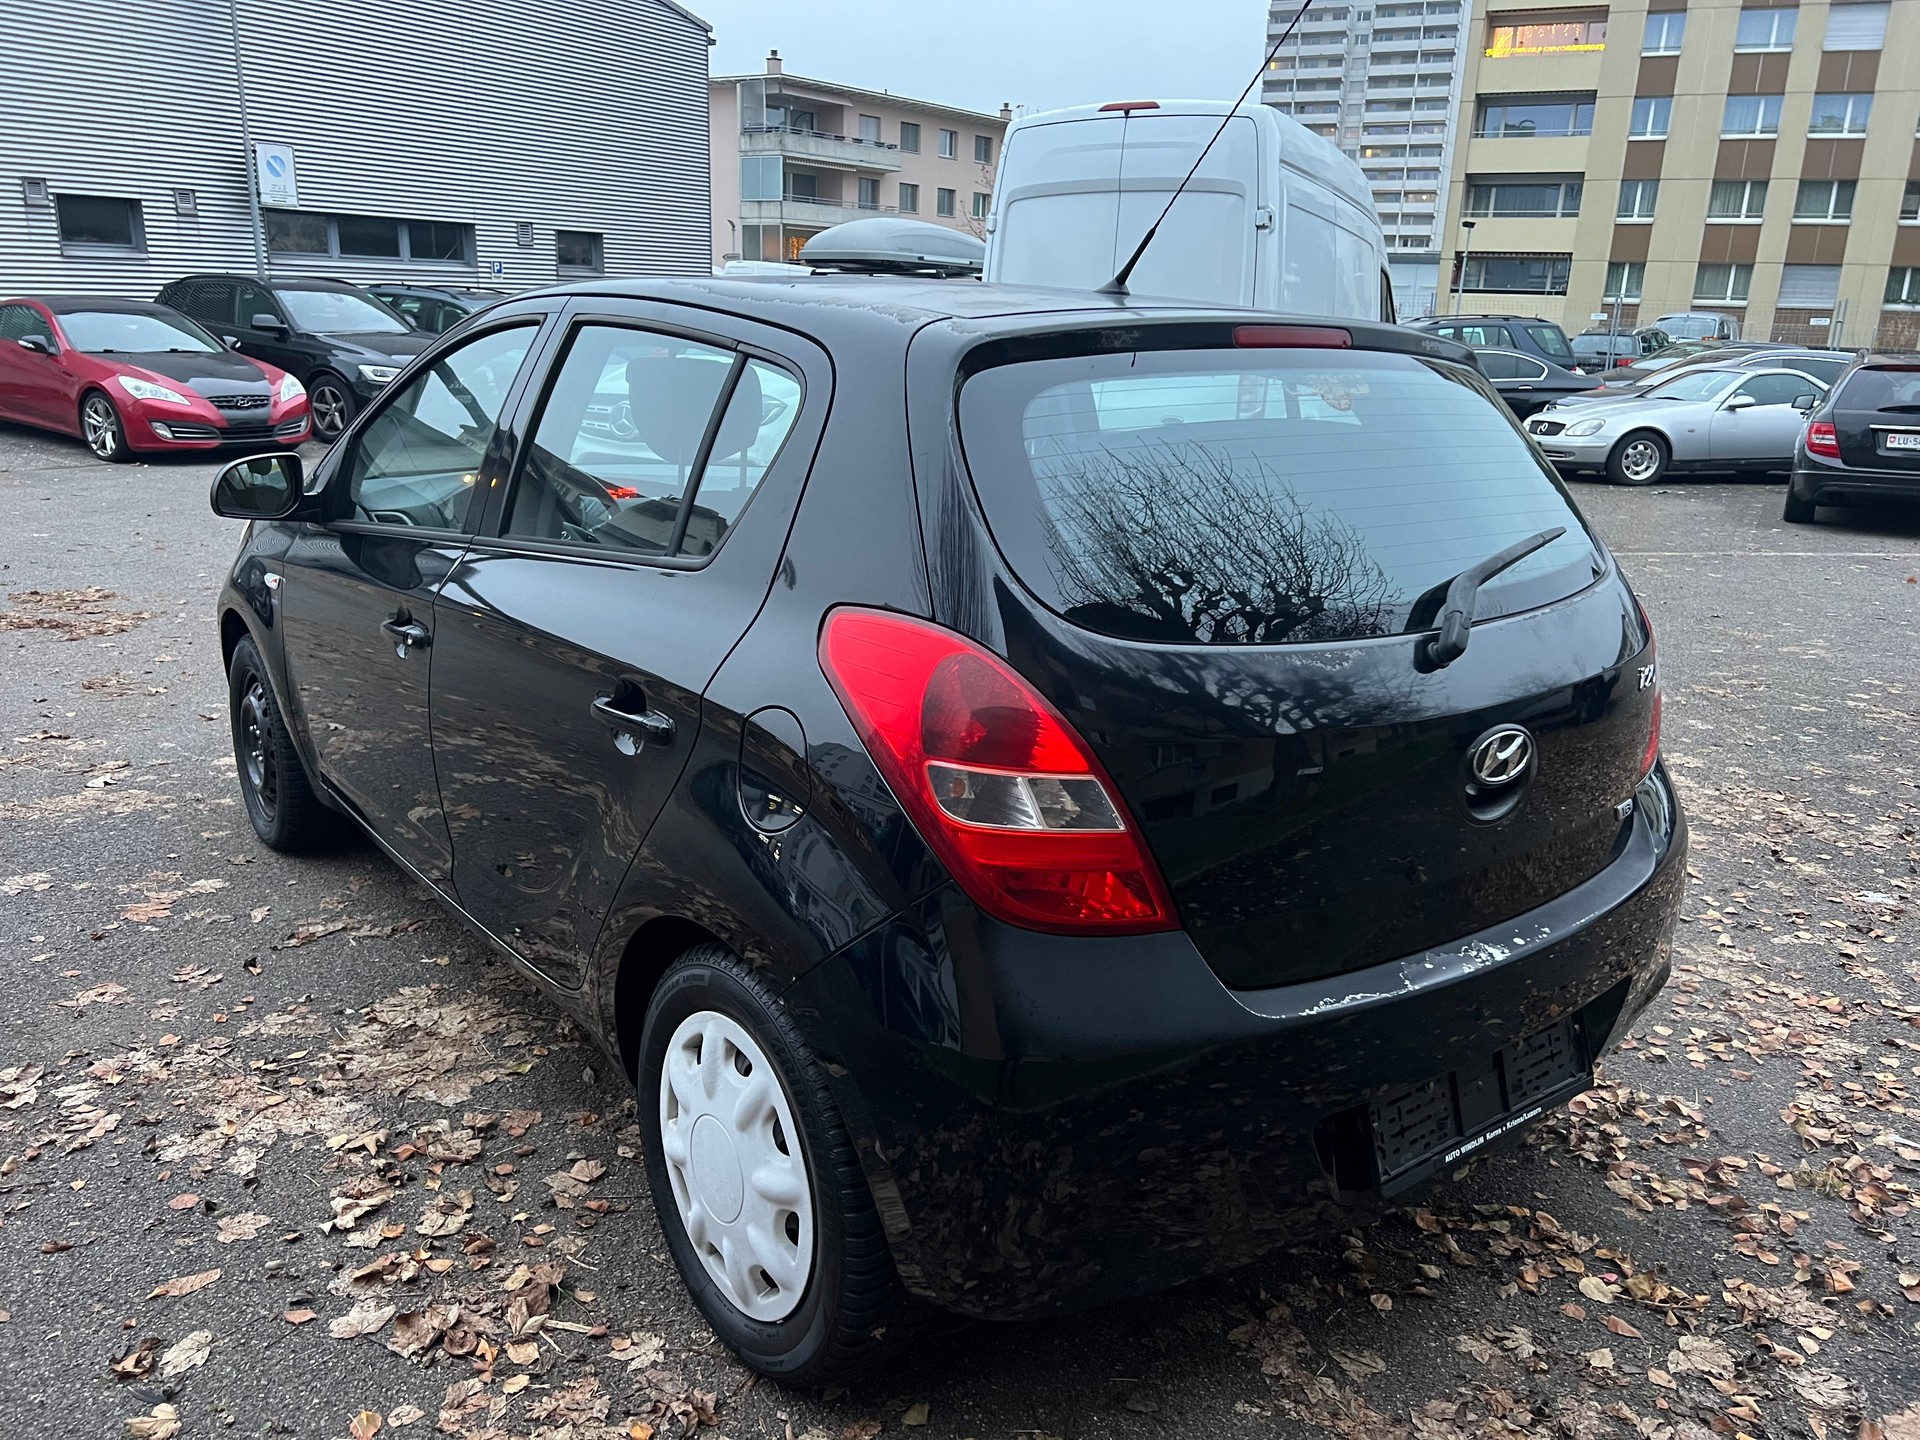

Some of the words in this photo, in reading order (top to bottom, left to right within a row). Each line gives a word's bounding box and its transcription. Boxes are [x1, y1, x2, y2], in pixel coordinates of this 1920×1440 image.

[1445, 1149, 1460, 1163] AUTO
[1460, 1136, 1484, 1153] WINDLIN
[1486, 1128, 1502, 1140] Kerns
